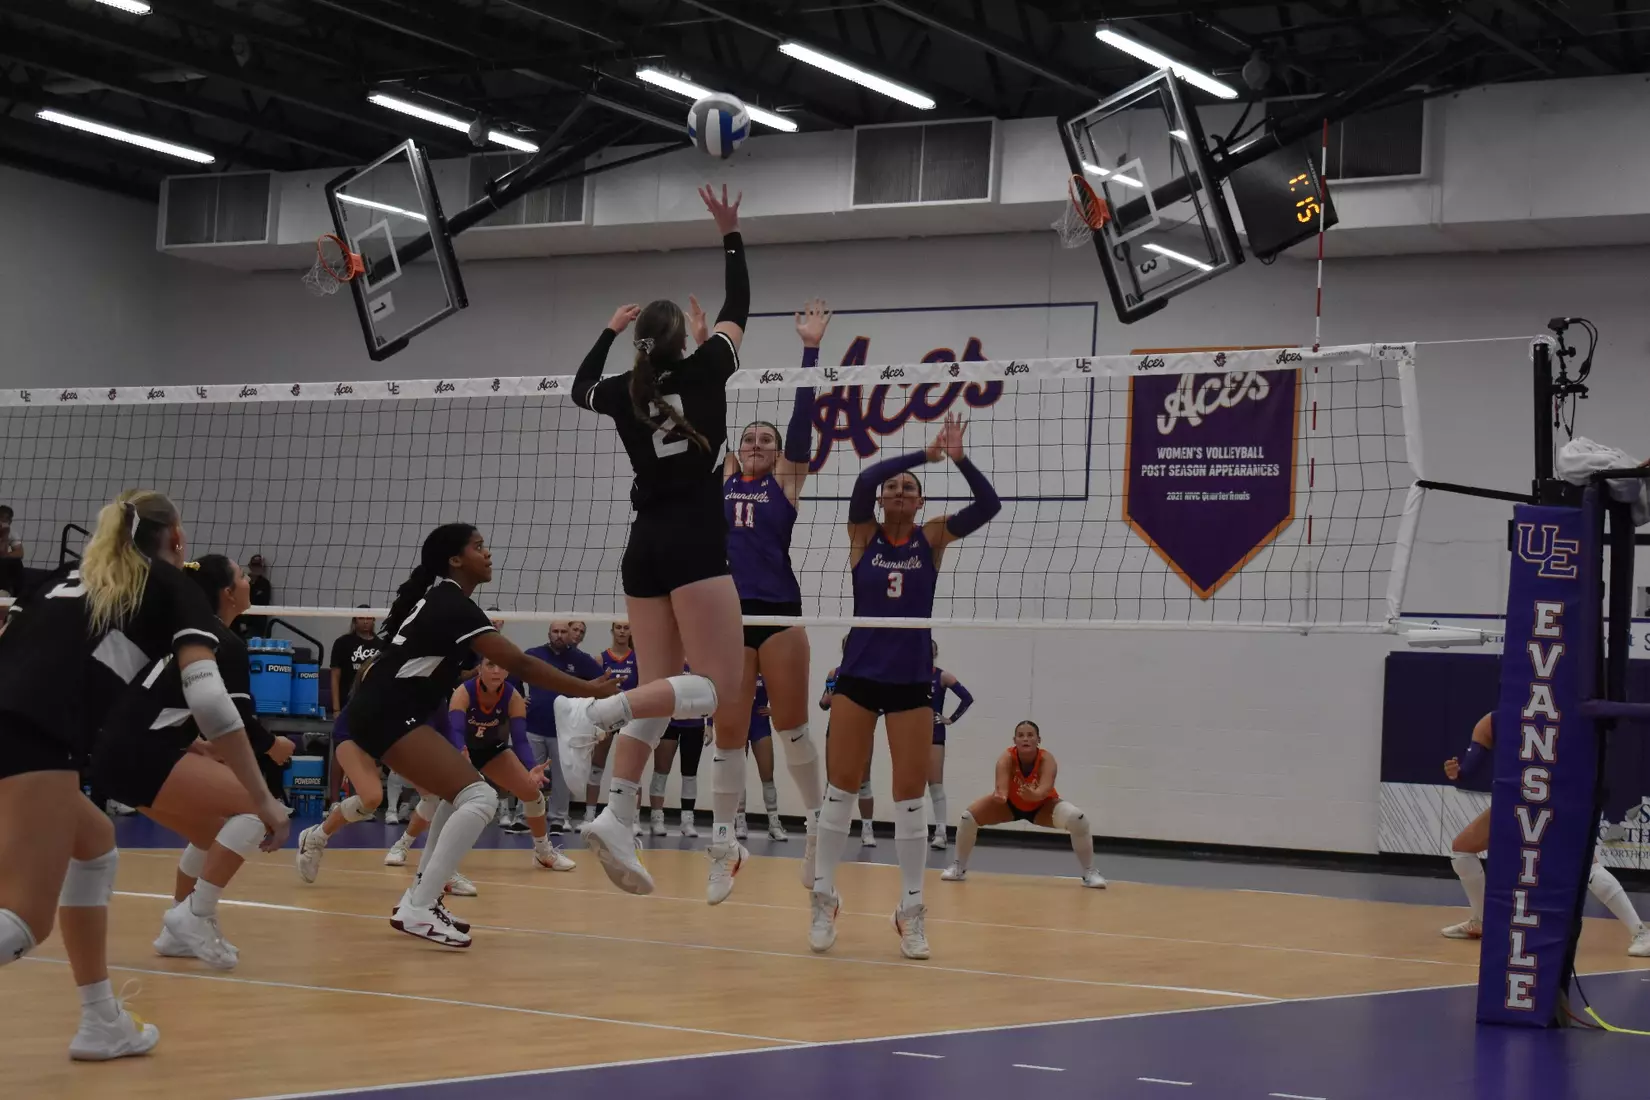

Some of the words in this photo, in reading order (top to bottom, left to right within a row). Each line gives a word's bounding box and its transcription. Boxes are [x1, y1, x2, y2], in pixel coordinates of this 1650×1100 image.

[1157, 447, 1203, 459] WOMEN'S
[1206, 446, 1264, 459] VOLLEYBALL
[1141, 465, 1166, 477] POST
[1168, 464, 1206, 477] SEASON
[1208, 464, 1280, 477] APPEARANCES
[1517, 523, 1580, 579] UE
[887, 571, 903, 598] 3
[1503, 600, 1566, 1011] EVANSVILLE
